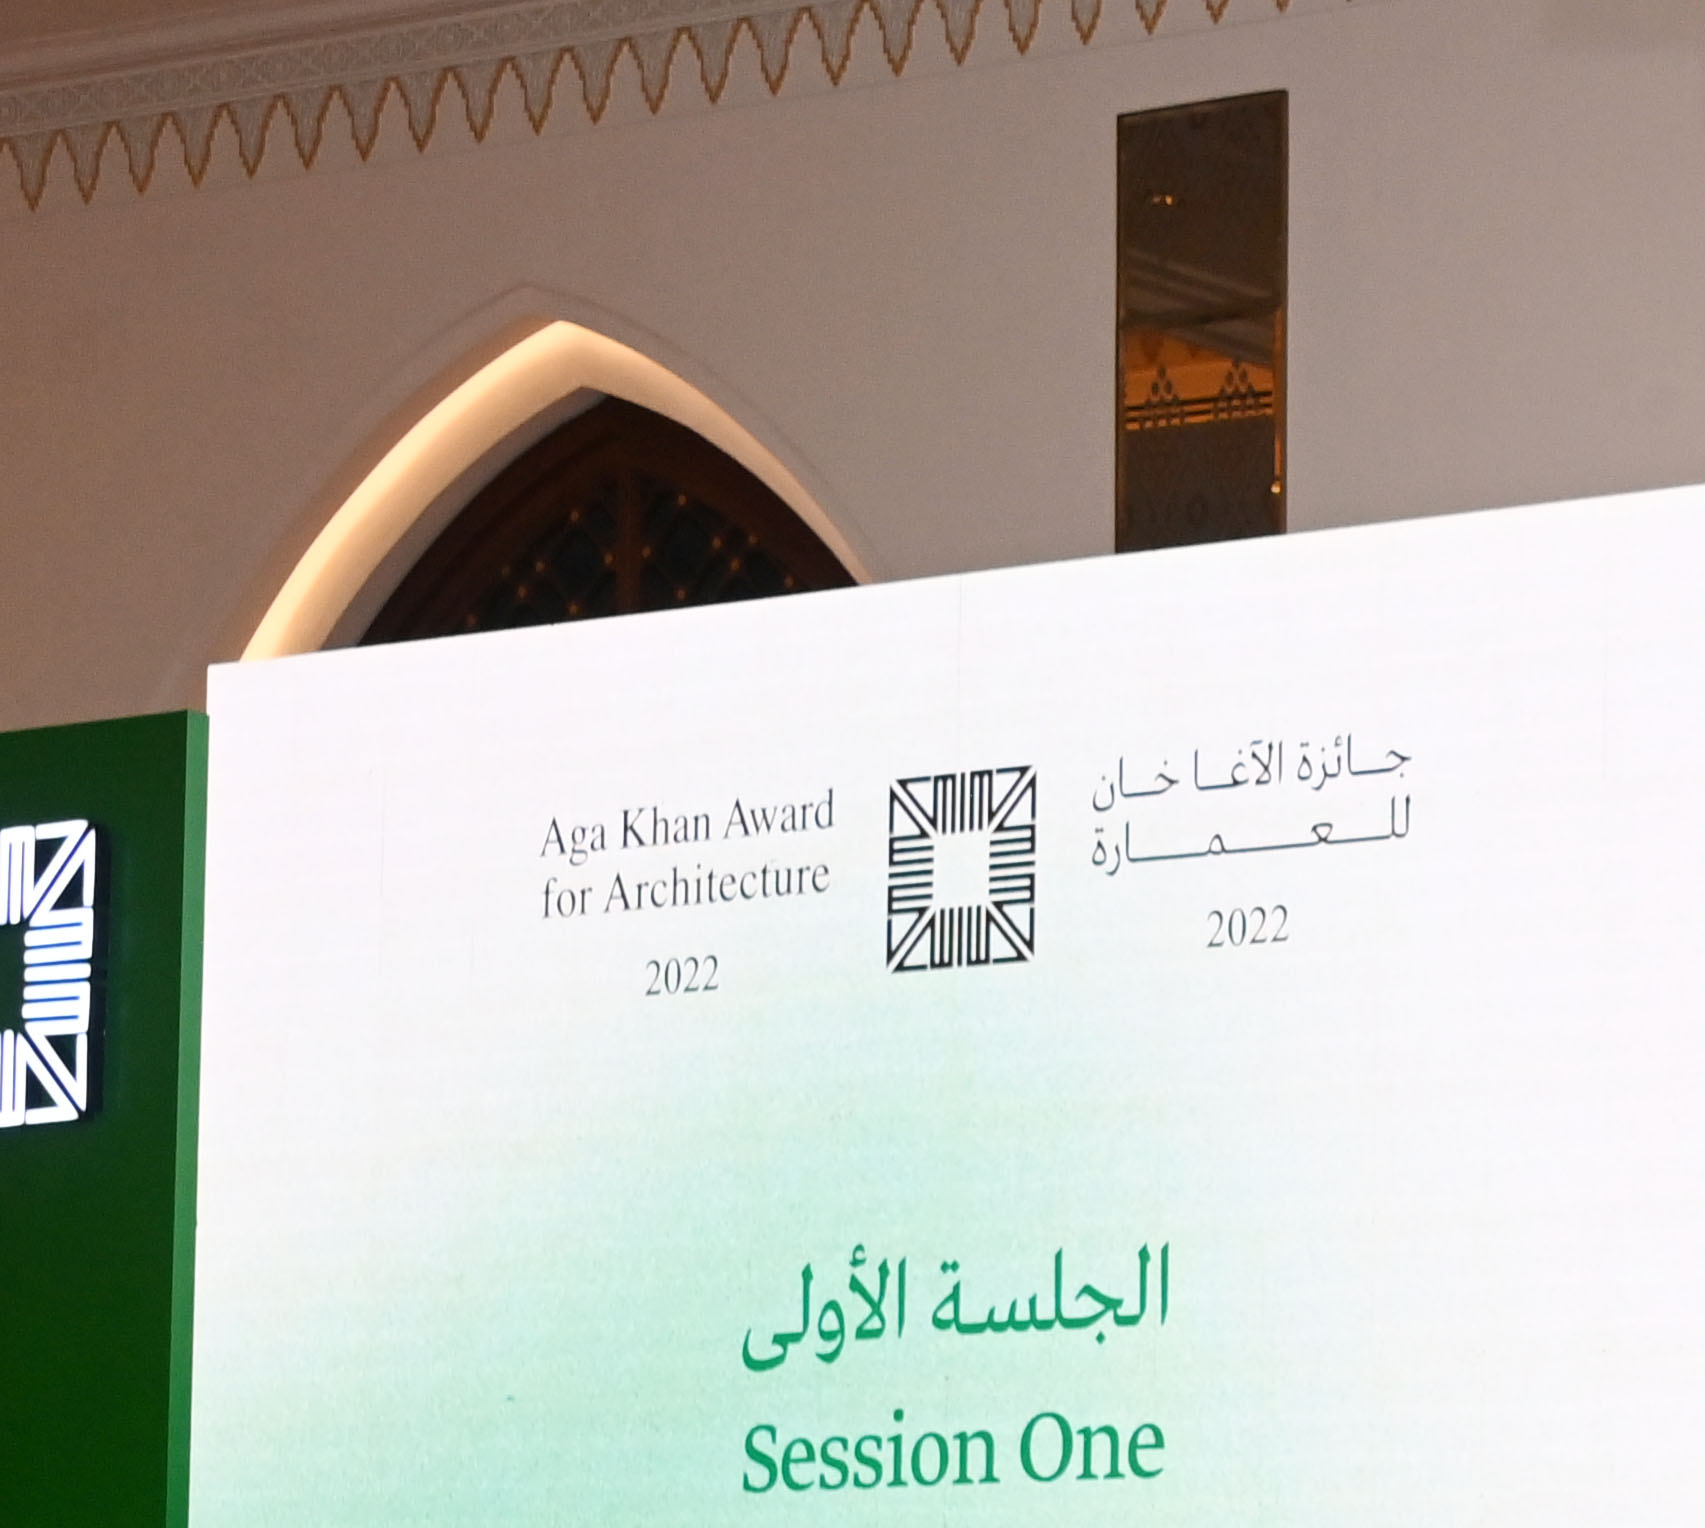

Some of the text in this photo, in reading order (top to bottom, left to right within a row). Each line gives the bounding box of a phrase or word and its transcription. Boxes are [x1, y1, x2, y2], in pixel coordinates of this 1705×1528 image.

[541, 787, 834, 866] Aga Khan Award
[542, 863, 830, 918] for Architecture
[1207, 904, 1288, 948] 2022
[645, 954, 718, 996] 2022
[741, 1241, 1169, 1373] الجلسة الأولى
[742, 1408, 1165, 1494] Session One
